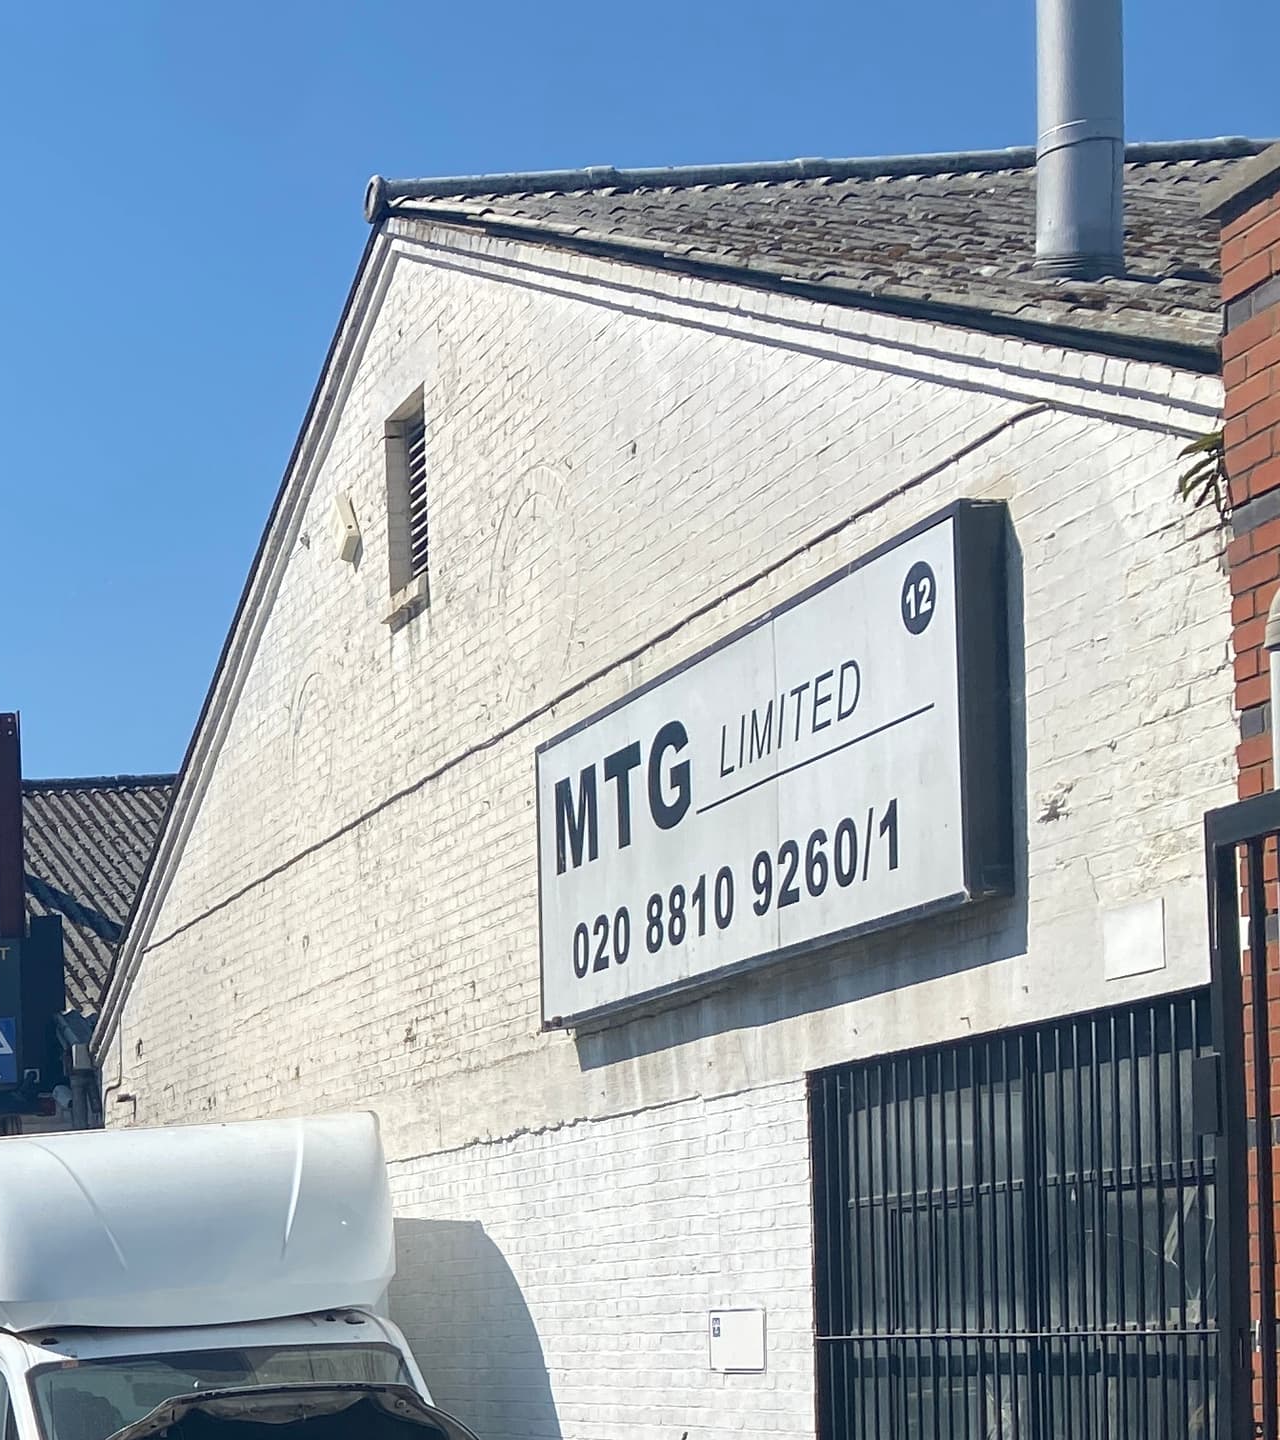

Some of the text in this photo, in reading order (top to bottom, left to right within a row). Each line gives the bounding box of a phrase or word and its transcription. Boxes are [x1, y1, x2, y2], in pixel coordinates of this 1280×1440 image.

[905, 575, 933, 620] 12
[554, 659, 861, 876] MTG LIMITED
[573, 797, 900, 979] 020 8810 9260/1
